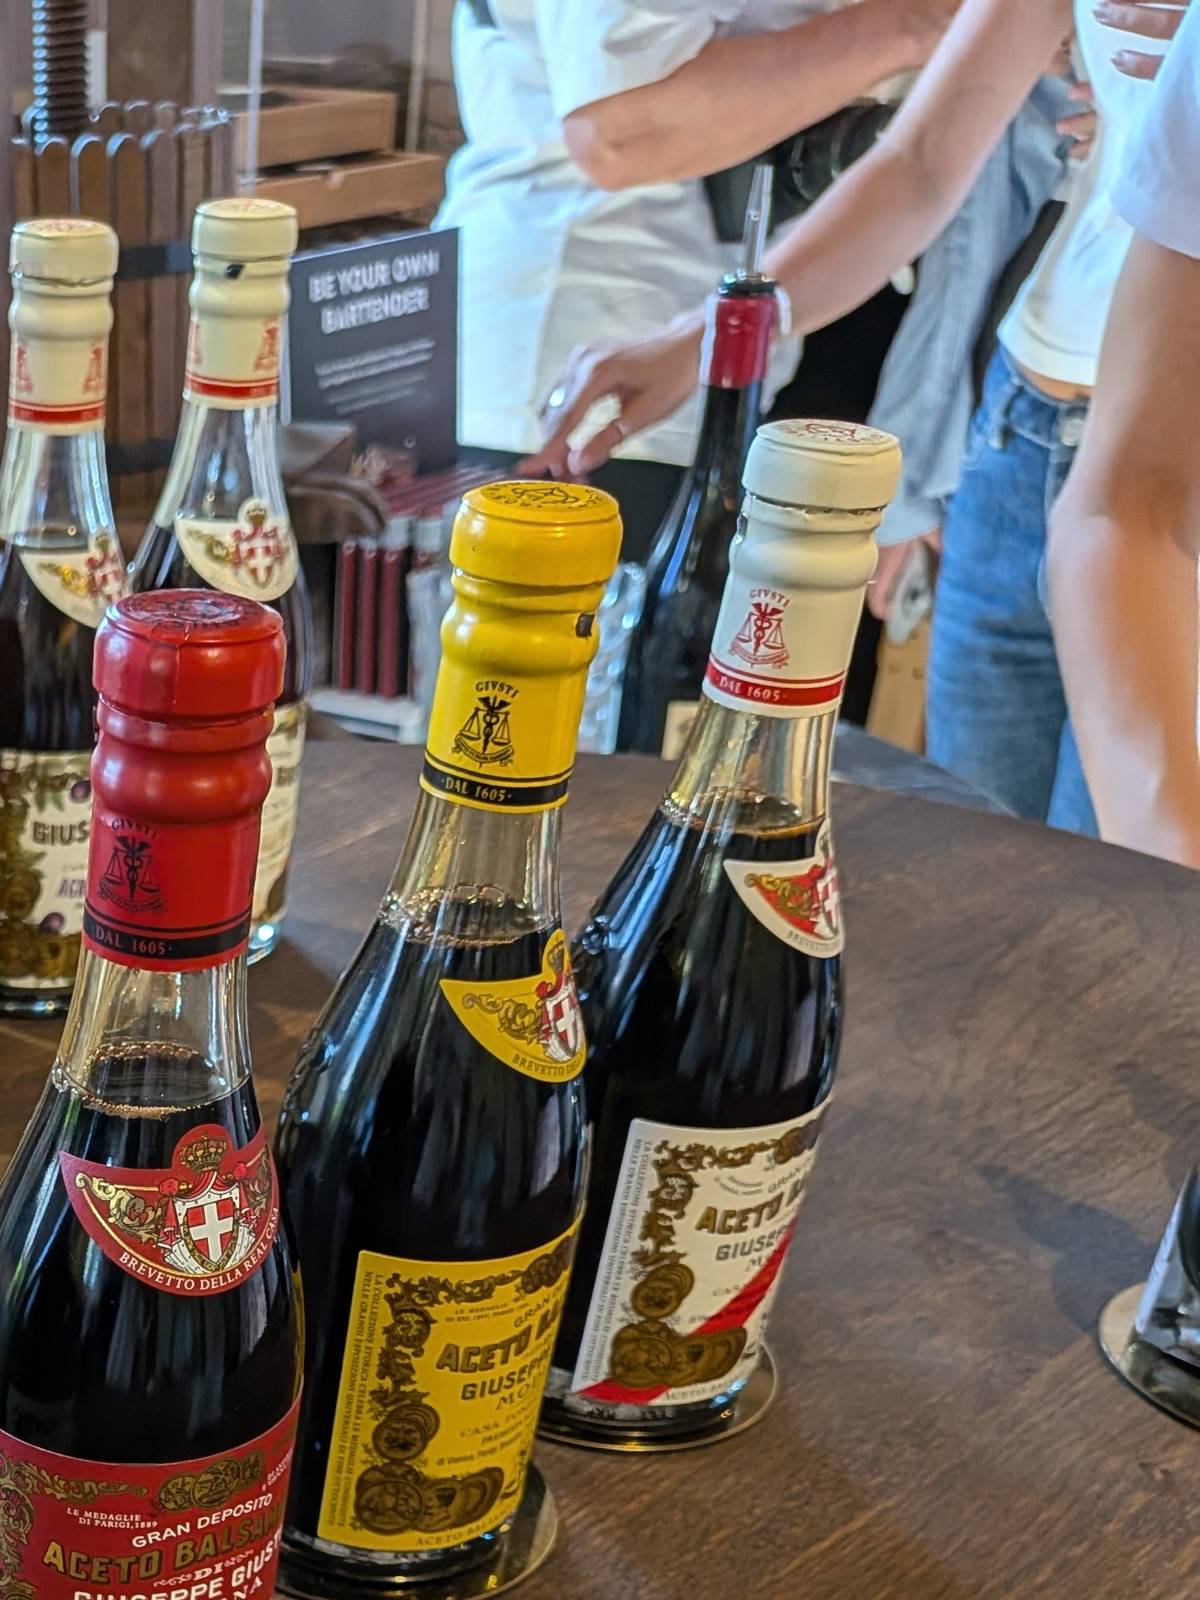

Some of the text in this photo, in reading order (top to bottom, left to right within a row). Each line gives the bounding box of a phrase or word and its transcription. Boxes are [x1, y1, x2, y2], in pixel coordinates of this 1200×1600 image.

[308, 249, 440, 303] BE YOUR OWN
[321, 283, 430, 334] BARTENDER
[749, 588, 790, 608] GIVSTI
[475, 680, 520, 699] GIVSTI
[719, 676, 781, 702] DAL 1605
[444, 777, 508, 802] DAL 1605
[32, 820, 89, 846] GIUS
[111, 818, 157, 840] GIVSTI
[94, 926, 166, 955] DAL 1605
[512, 1054, 565, 1076] BREVETTO
[694, 1192, 785, 1235] ACETO
[119, 1207, 280, 1291] BREVETTO DELLA REAL CASA
[435, 1324, 533, 1373] ACETO
[66, 1506, 142, 1522] LE MEDAGLIE
[78, 1516, 92, 1526] DI
[131, 1492, 273, 1549] GRAN DEPOSITO
[42, 1502, 283, 1586] ACETO BALSAM
[193, 1561, 224, 1581] DI
